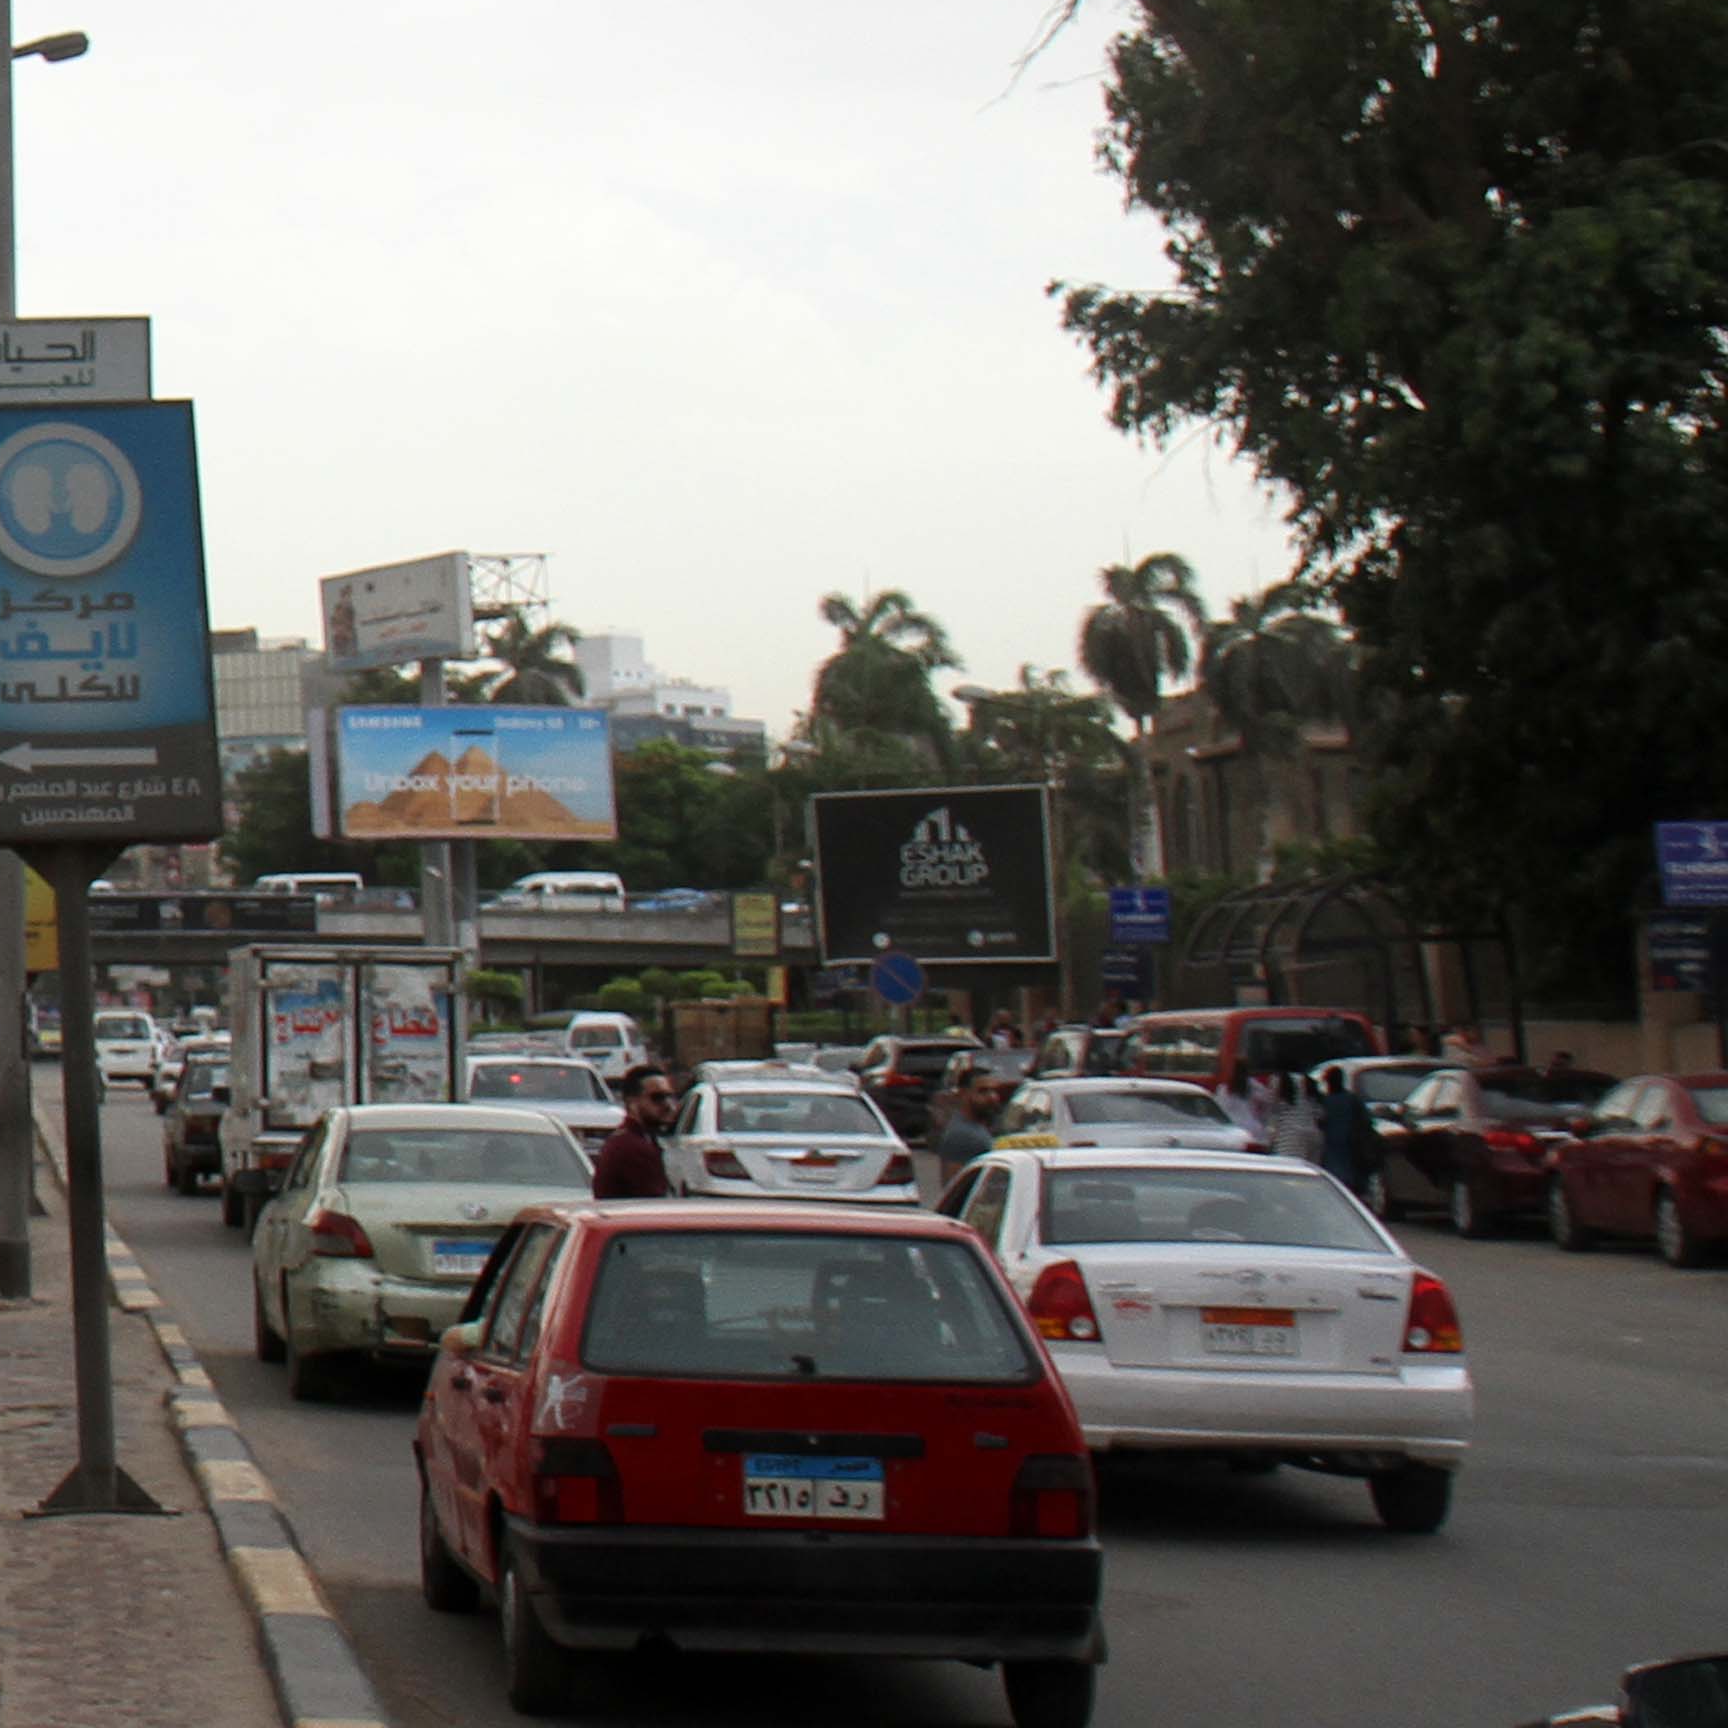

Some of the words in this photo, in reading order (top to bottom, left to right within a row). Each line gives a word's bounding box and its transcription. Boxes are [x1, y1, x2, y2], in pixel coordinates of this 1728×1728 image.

[0, 621, 139, 671] لايف
[349, 716, 423, 729] SAMSUNG
[899, 842, 985, 864] ESHAK
[899, 863, 990, 888] GROUP
